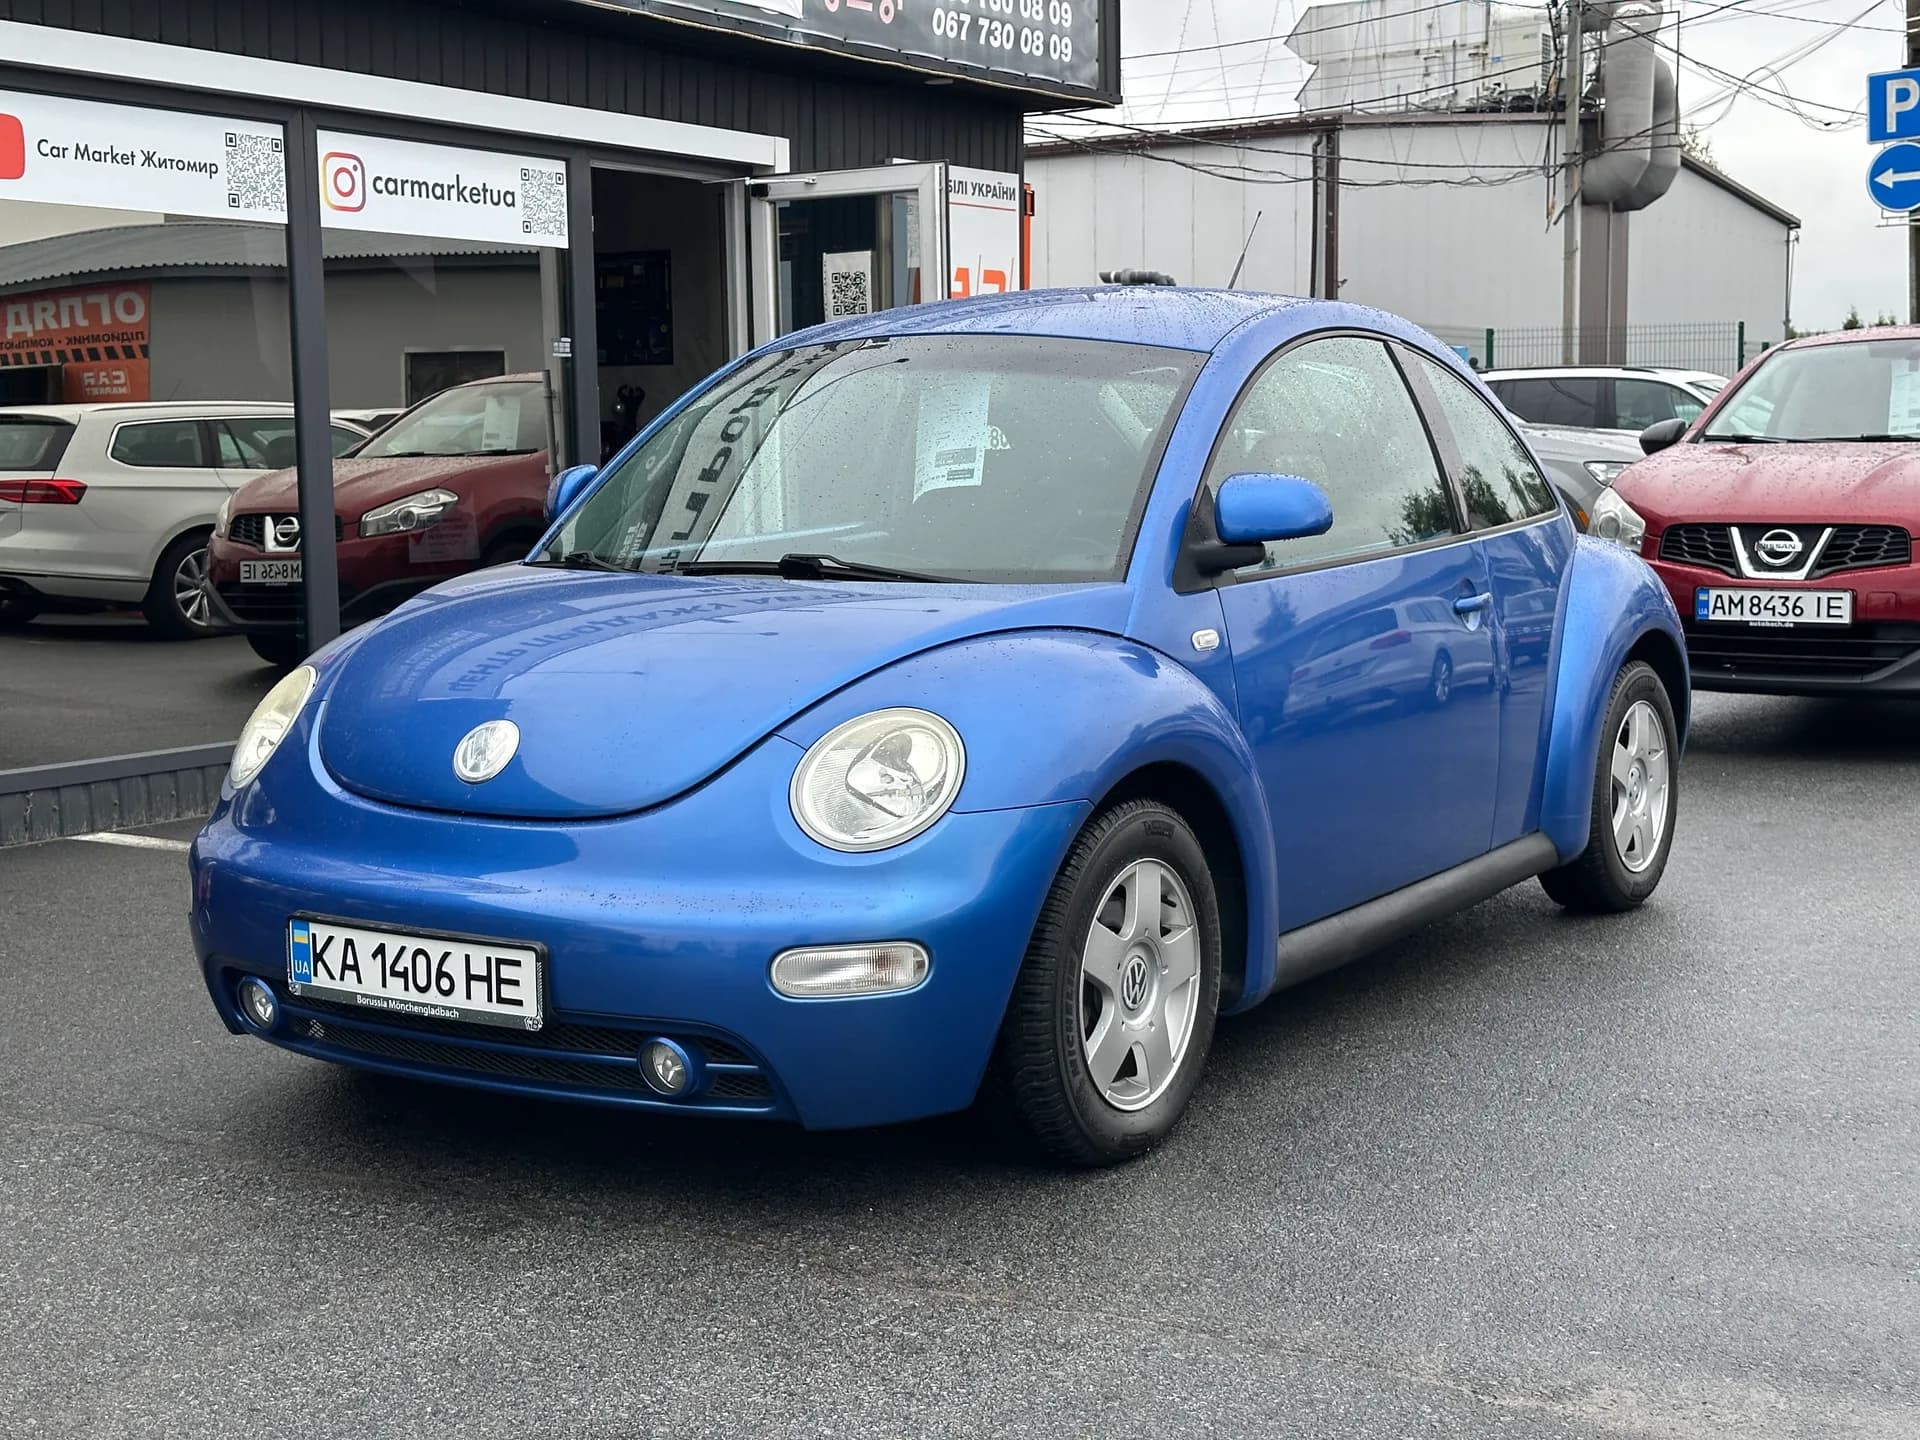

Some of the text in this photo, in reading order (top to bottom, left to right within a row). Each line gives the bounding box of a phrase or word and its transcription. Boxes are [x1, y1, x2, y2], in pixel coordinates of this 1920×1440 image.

[1050, 0, 1072, 28] 09
[932, 7, 971, 40] 067
[978, 17, 1015, 50] 730
[1020, 27, 1044, 57] 08
[1050, 34, 1072, 63] 09
[1886, 78, 1920, 133] P
[37, 139, 219, 179] Car Market Житомир
[373, 173, 516, 208] carmarketua
[970, 181, 1016, 201] УКРАЇНИ
[1758, 542, 1796, 550] NISSAN
[1712, 594, 1744, 616] AM
[1749, 595, 1804, 616] 8436
[1816, 596, 1844, 618] IE
[294, 932, 524, 1008] UA KA 1406 HE
[356, 994, 460, 1019] Borussia Mönchengladbach
